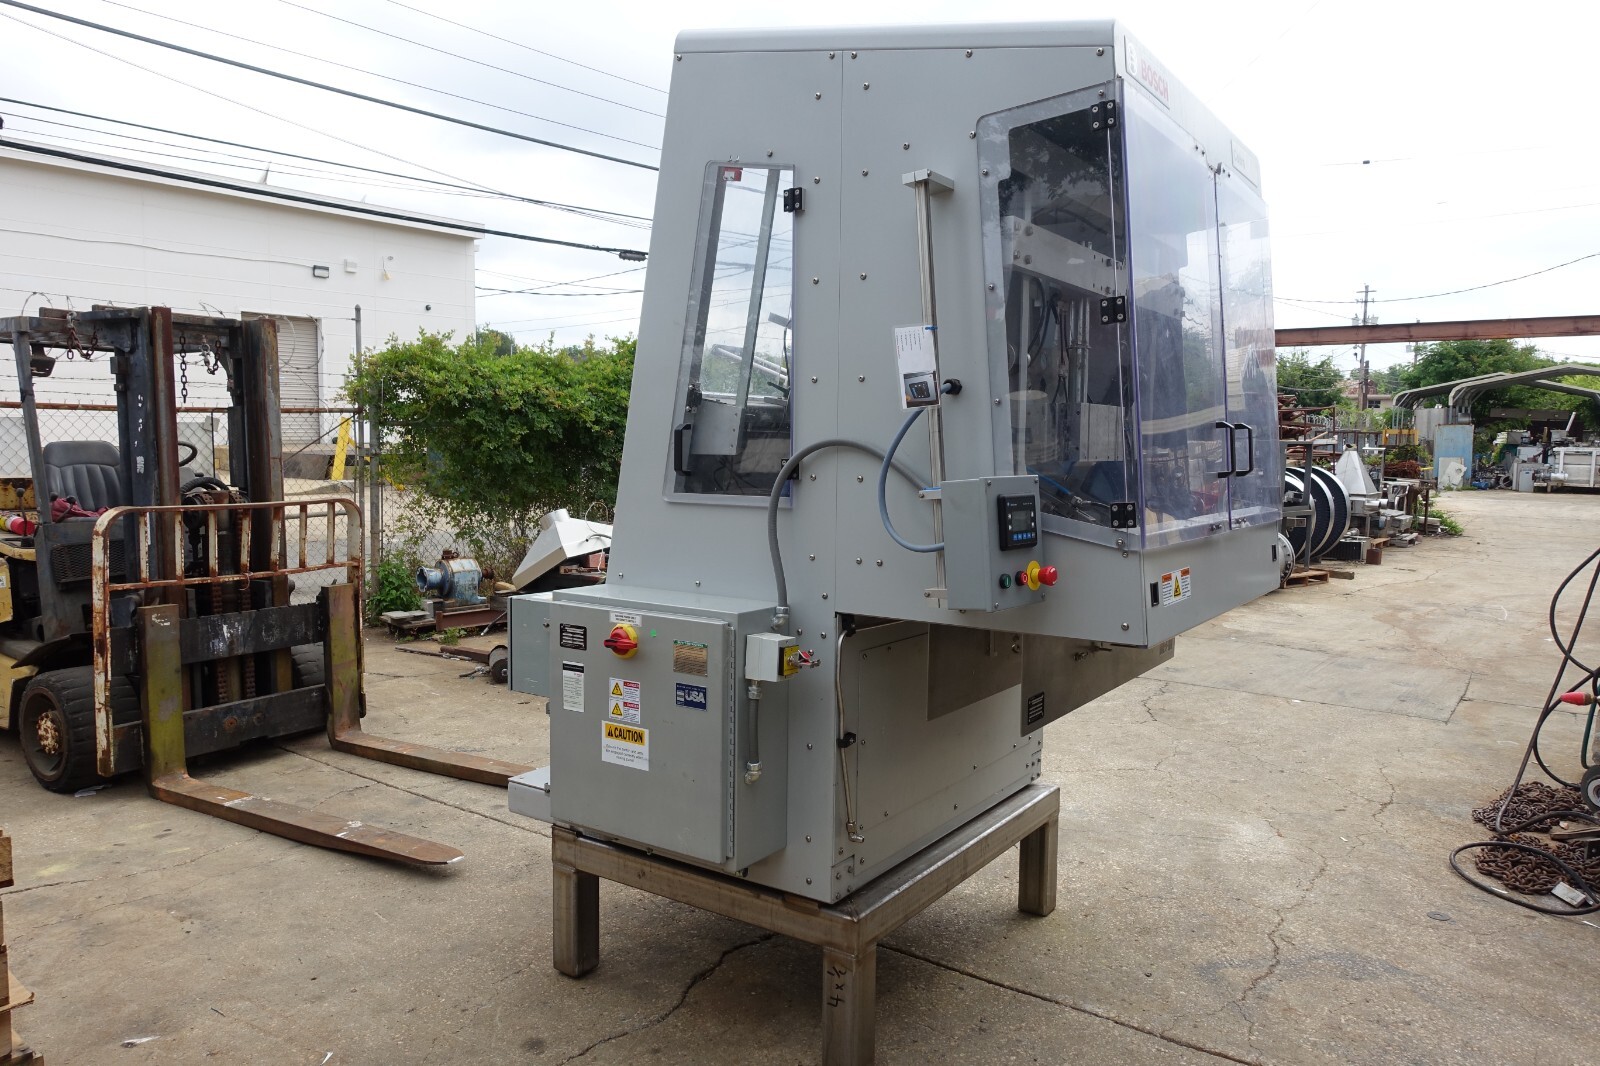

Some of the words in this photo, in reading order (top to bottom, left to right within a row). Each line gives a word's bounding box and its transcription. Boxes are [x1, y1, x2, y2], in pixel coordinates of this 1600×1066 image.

[1141, 58, 1169, 101] BOSCH
[685, 689, 706, 703] USA
[614, 727, 643, 744] CAUTION
[827, 994, 845, 1007] 4
